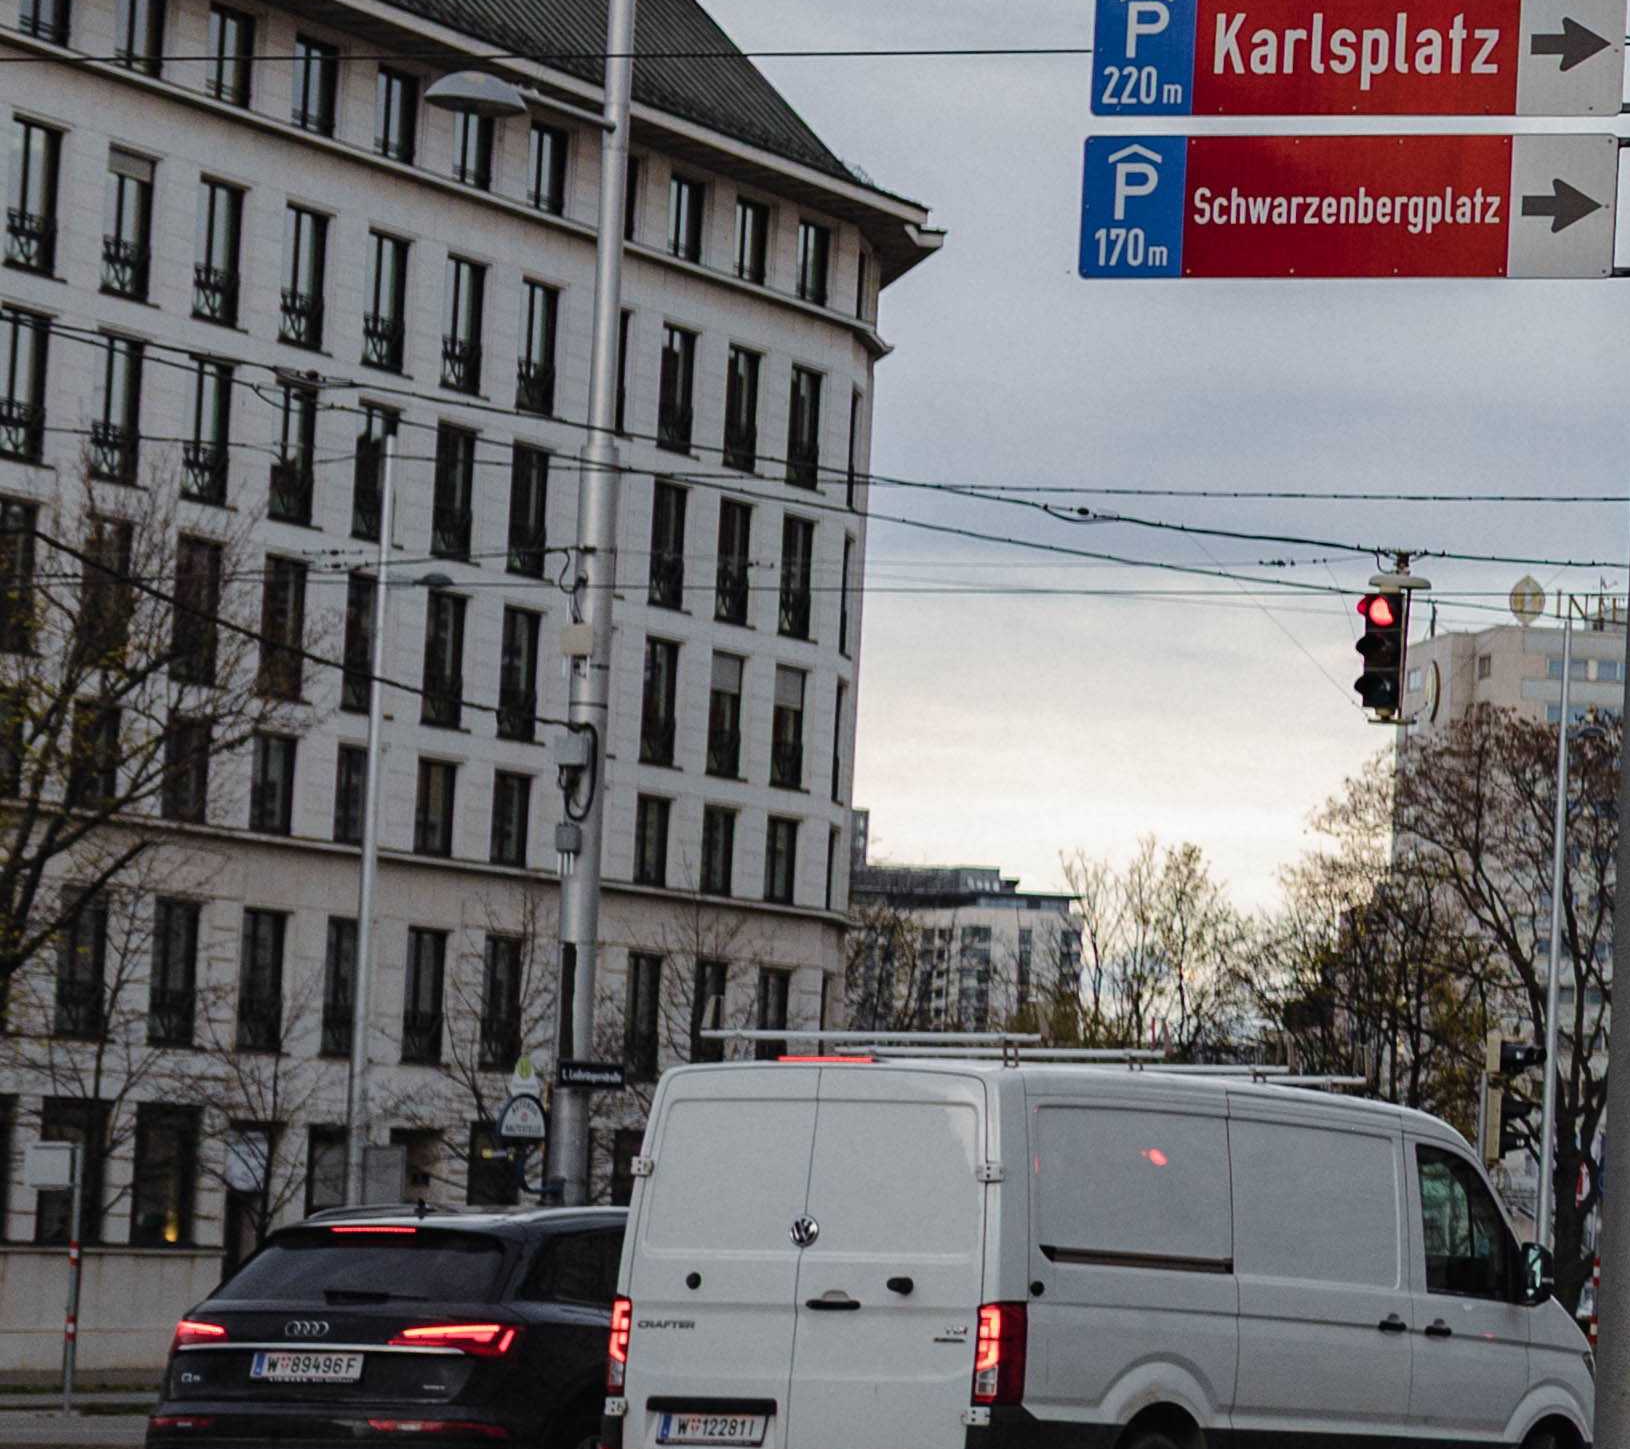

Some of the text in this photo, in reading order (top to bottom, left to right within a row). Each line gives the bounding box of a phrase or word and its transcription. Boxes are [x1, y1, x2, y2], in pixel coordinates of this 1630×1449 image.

[1126, 1, 1499, 91] P Karlsplatz
[1114, 164, 1501, 234] P Schwarzenbergplatz
